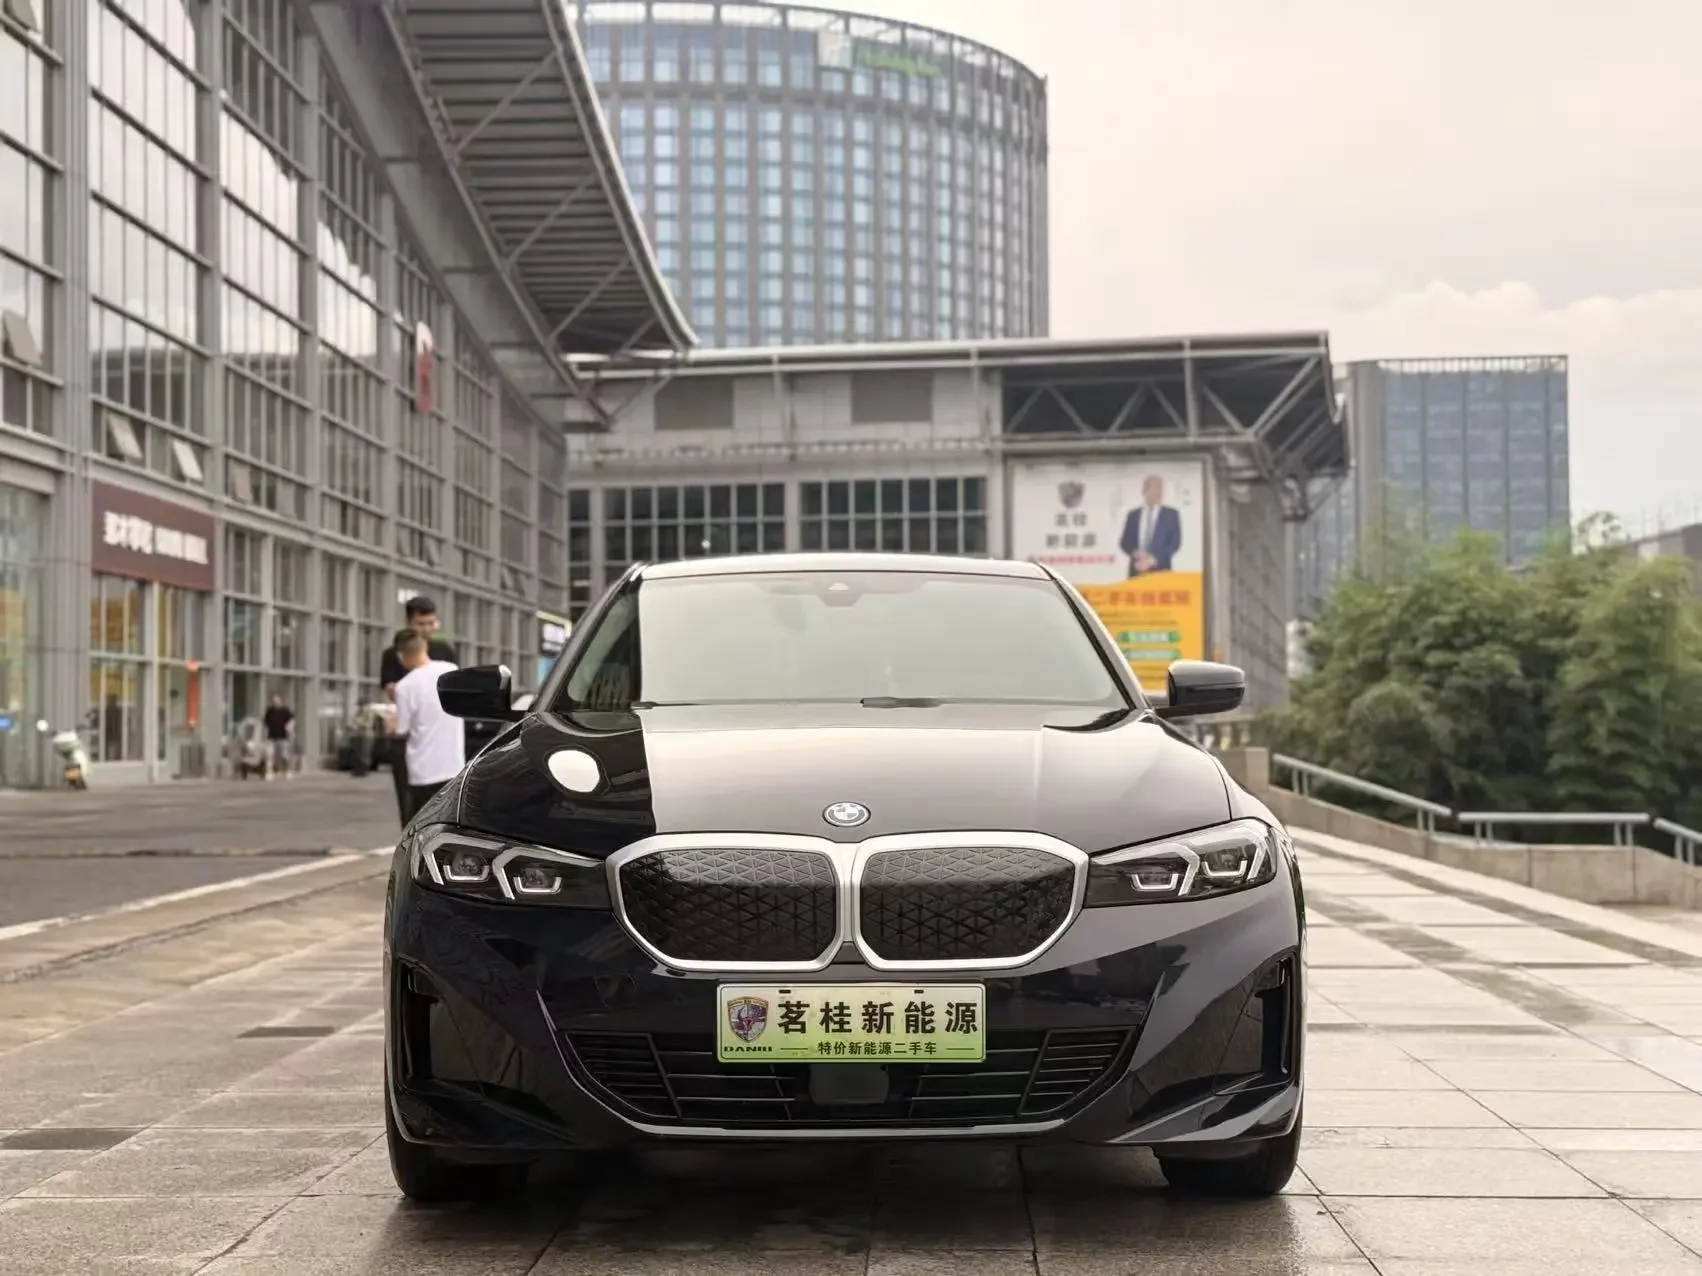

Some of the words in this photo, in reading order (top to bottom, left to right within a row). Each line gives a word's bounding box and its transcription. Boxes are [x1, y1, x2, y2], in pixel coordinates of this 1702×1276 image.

[777, 1000, 978, 1034] 茗桂新能源
[817, 1041, 937, 1055] 特价新能源二手车
